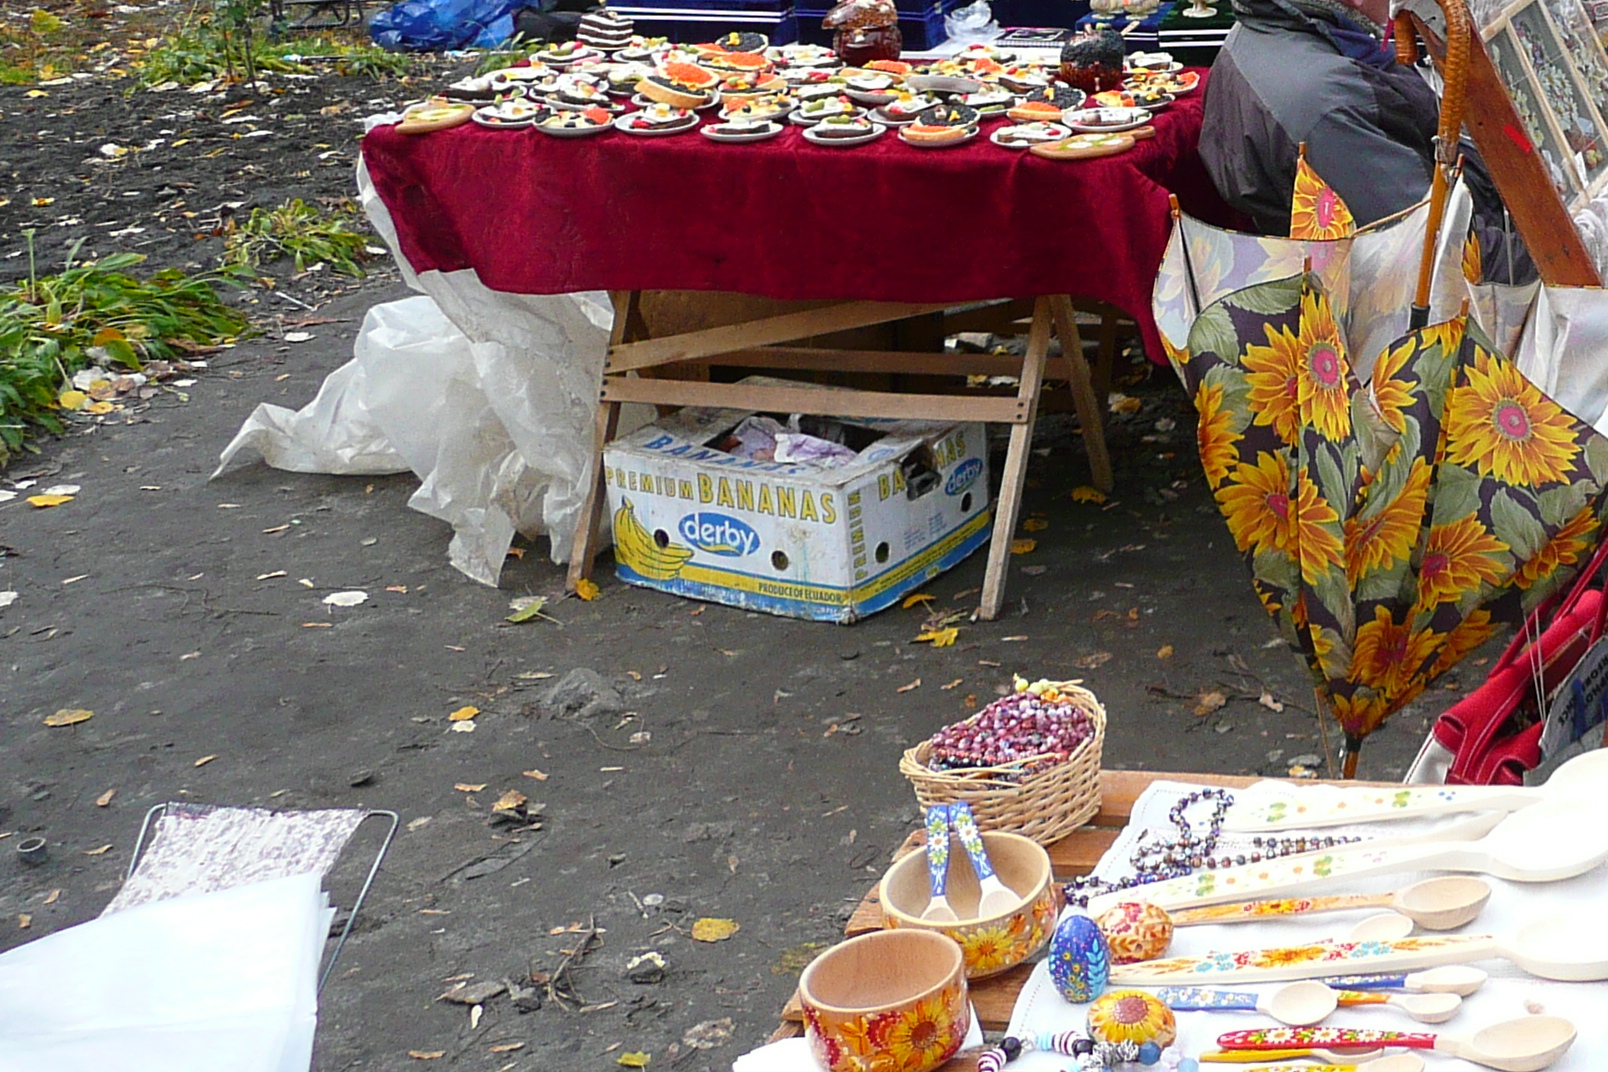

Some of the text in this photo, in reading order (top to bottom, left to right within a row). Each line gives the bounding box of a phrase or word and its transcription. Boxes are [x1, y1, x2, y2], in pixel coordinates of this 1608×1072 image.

[877, 430, 967, 502] BANAS
[948, 462, 982, 494] derby
[604, 465, 837, 525] PREMIUM BANANAS
[683, 513, 755, 557] derby
[847, 489, 868, 581] PREMIUM
[758, 582, 842, 603] PRODUCE OF ECUADOR
